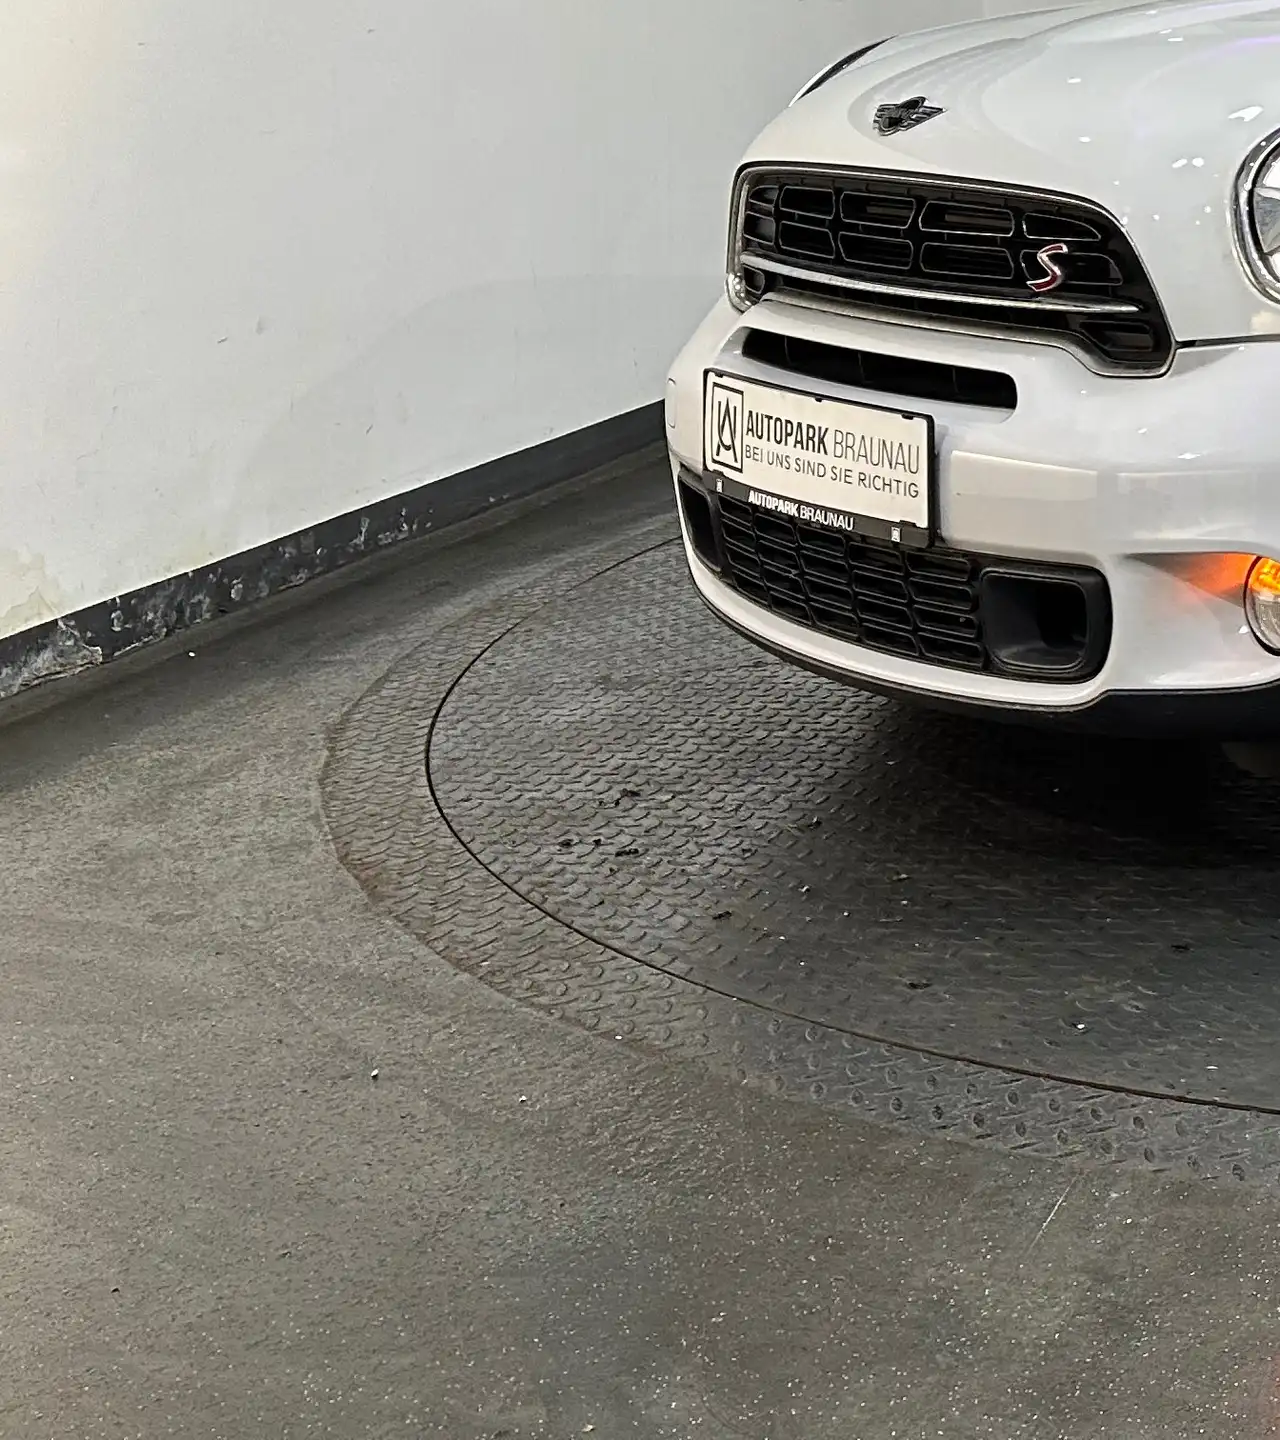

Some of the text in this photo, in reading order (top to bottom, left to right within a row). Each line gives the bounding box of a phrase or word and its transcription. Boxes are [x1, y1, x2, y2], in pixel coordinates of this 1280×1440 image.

[1025, 243, 1068, 293] S
[745, 410, 920, 474] AUTOPARK BRAUNAU
[745, 445, 919, 499] BEI UNS SIND SIE RICHTIG
[748, 490, 854, 531] AUTOPARK BRAUNAU
